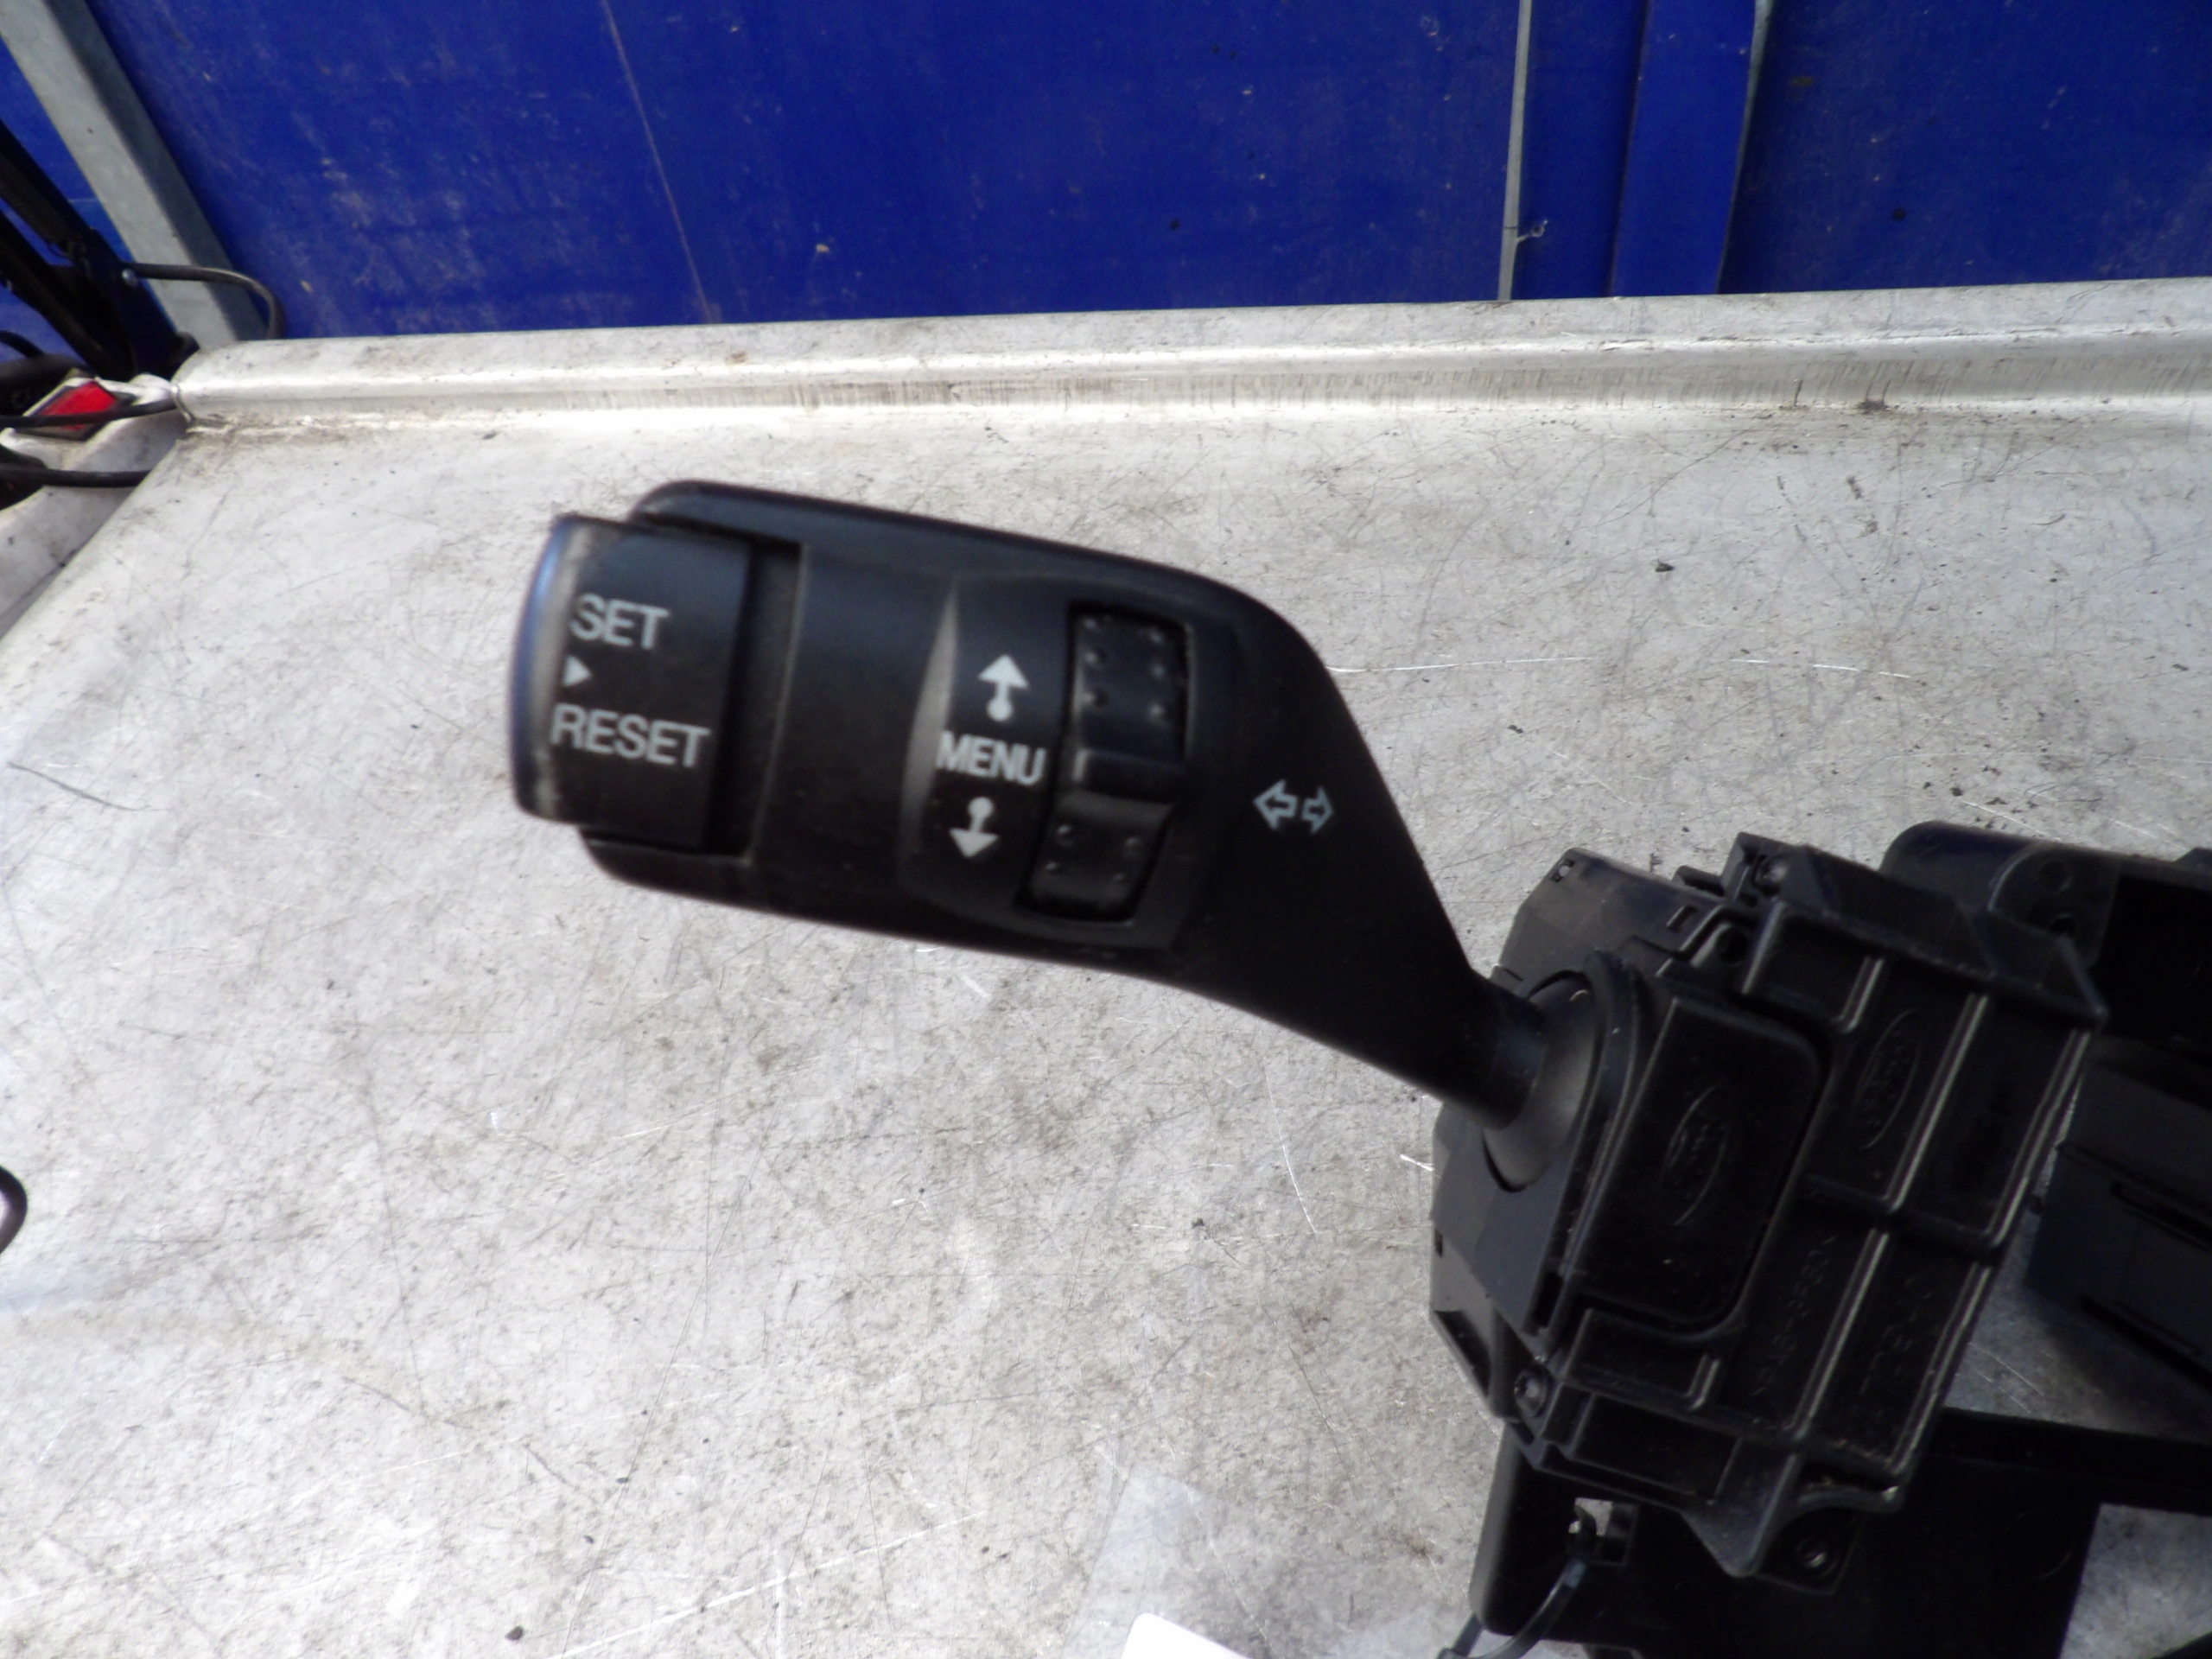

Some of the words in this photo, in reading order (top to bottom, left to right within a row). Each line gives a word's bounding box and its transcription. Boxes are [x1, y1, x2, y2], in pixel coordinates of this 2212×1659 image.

[569, 593, 671, 650] SET
[550, 702, 712, 768] RESET
[935, 729, 1047, 786] MENU
